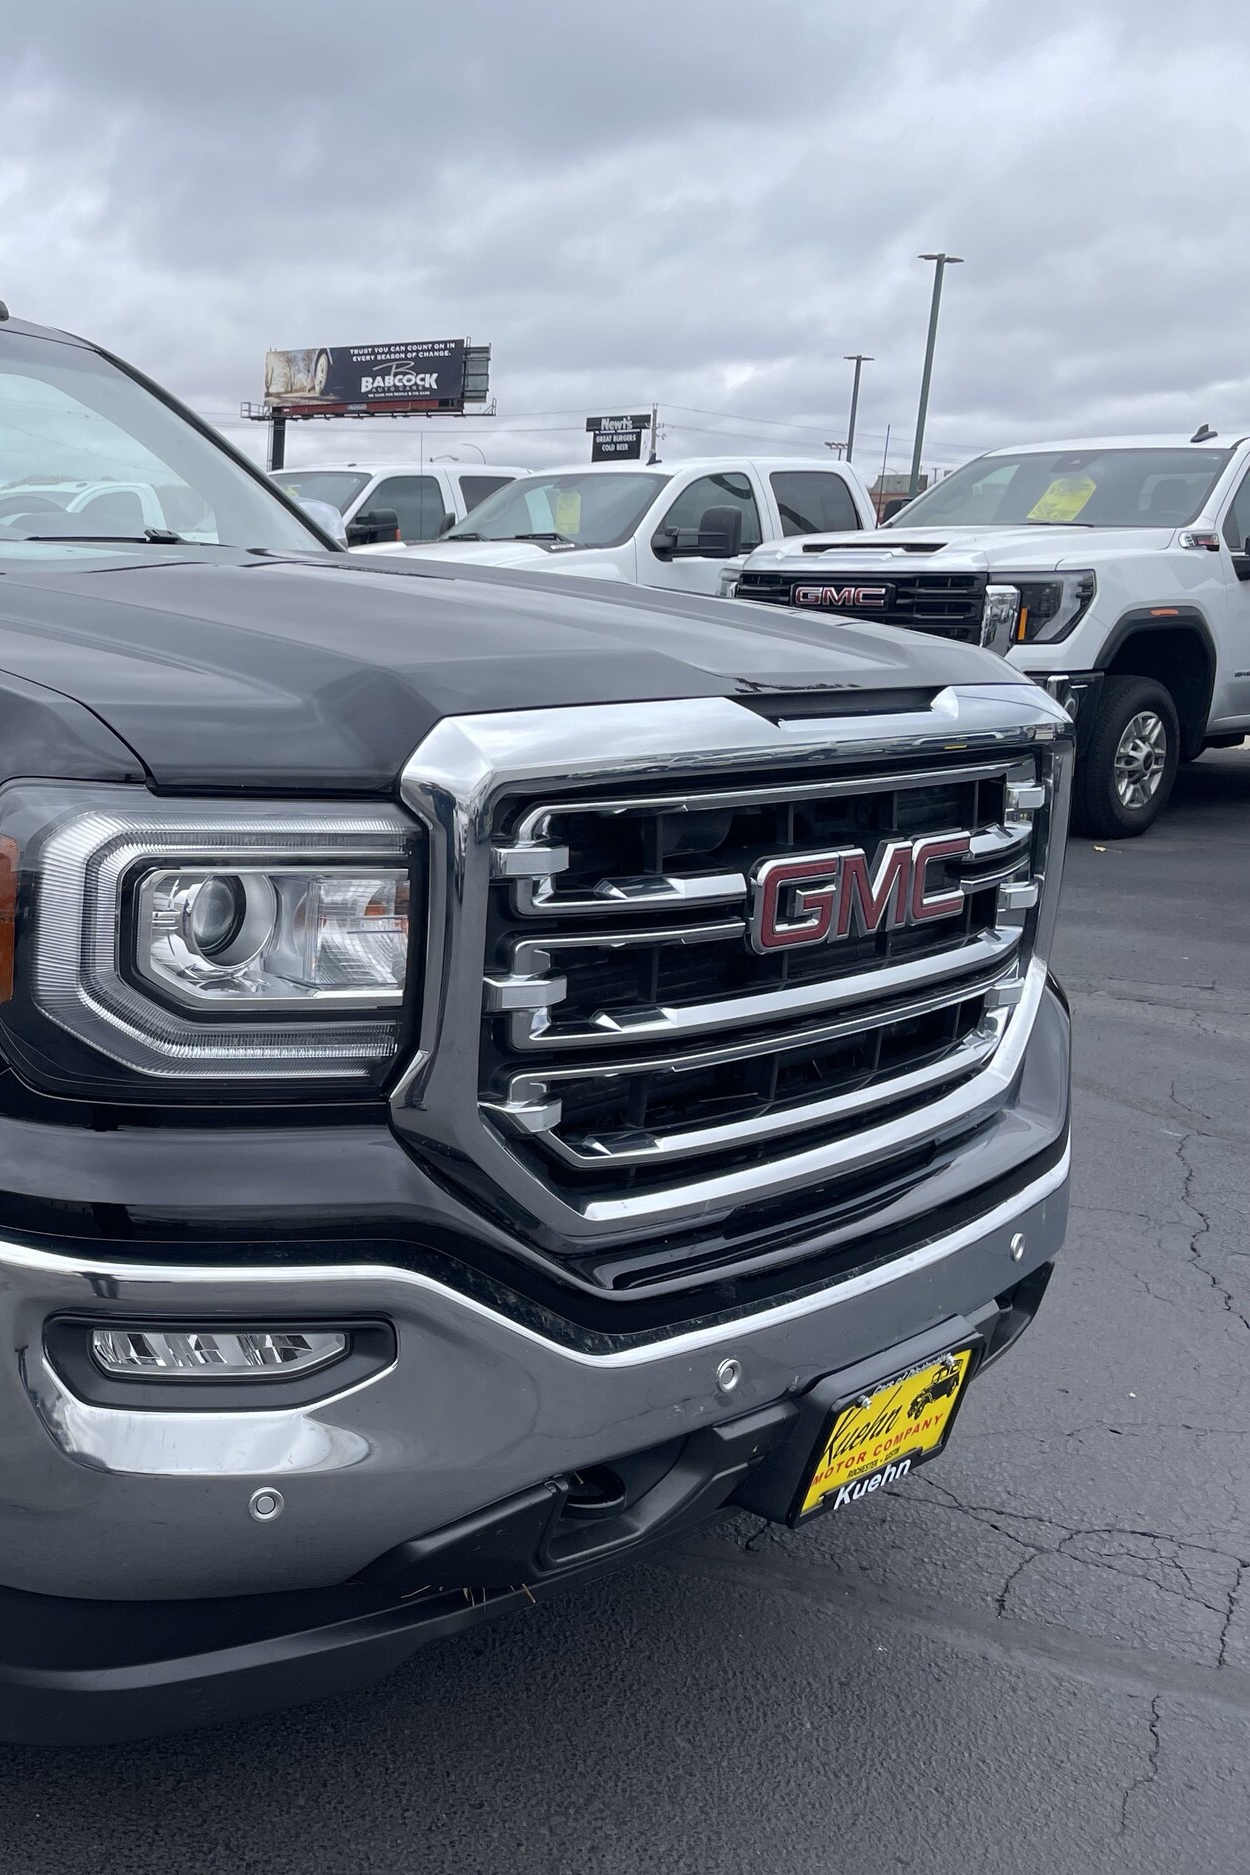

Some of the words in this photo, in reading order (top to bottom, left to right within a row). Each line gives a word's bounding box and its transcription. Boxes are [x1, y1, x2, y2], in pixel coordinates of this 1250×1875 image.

[376, 352, 405, 360] SEASON
[361, 373, 438, 393] BABCOCK
[601, 416, 633, 430] Newt's
[796, 587, 886, 606] GMC
[751, 831, 971, 955] GMC
[822, 1385, 903, 1468] Kuehn
[812, 1451, 867, 1487] MOTOR
[873, 1413, 944, 1457] COMPANY
[846, 1458, 879, 1479] ROCHESTER
[833, 1458, 912, 1511] Kuehn
